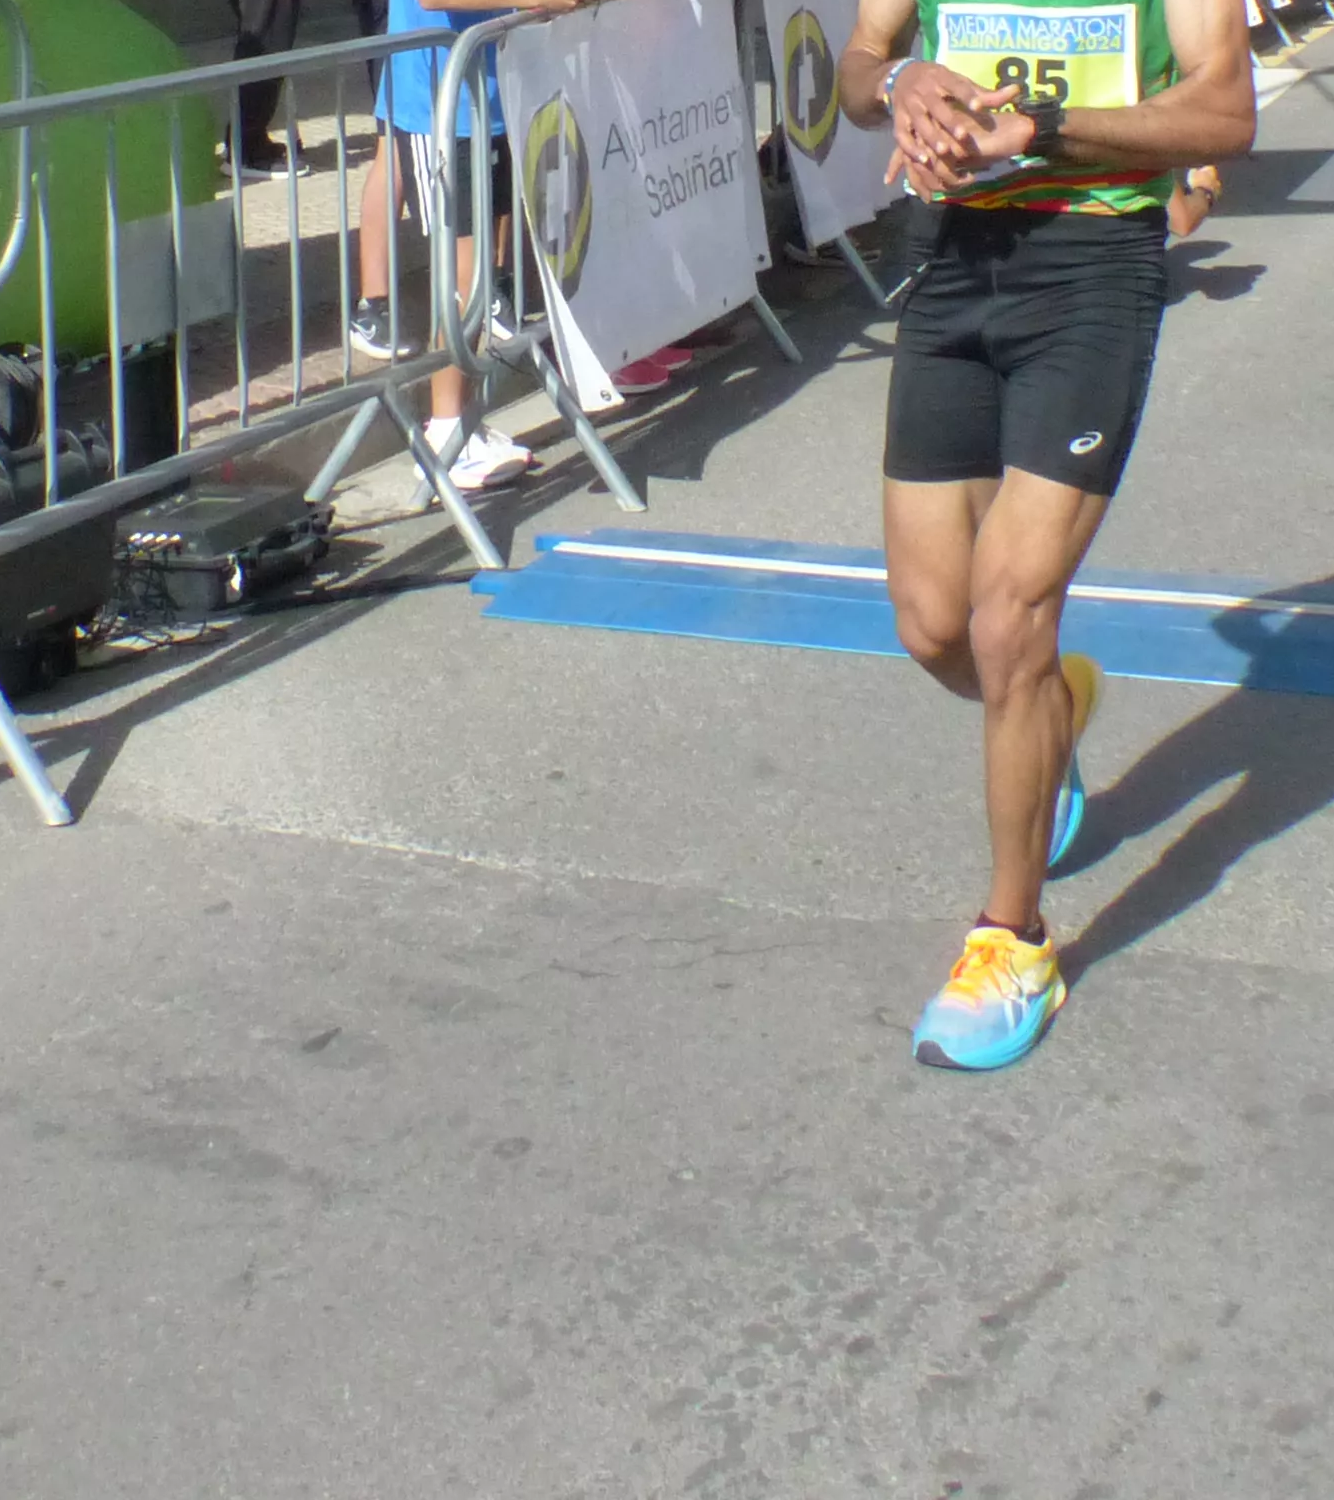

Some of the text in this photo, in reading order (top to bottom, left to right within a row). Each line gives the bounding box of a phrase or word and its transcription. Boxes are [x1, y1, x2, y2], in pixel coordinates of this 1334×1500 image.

[946, 15, 1125, 38] MEDIA MARATON
[1075, 34, 1121, 53] 2024
[995, 56, 1069, 102] 85
